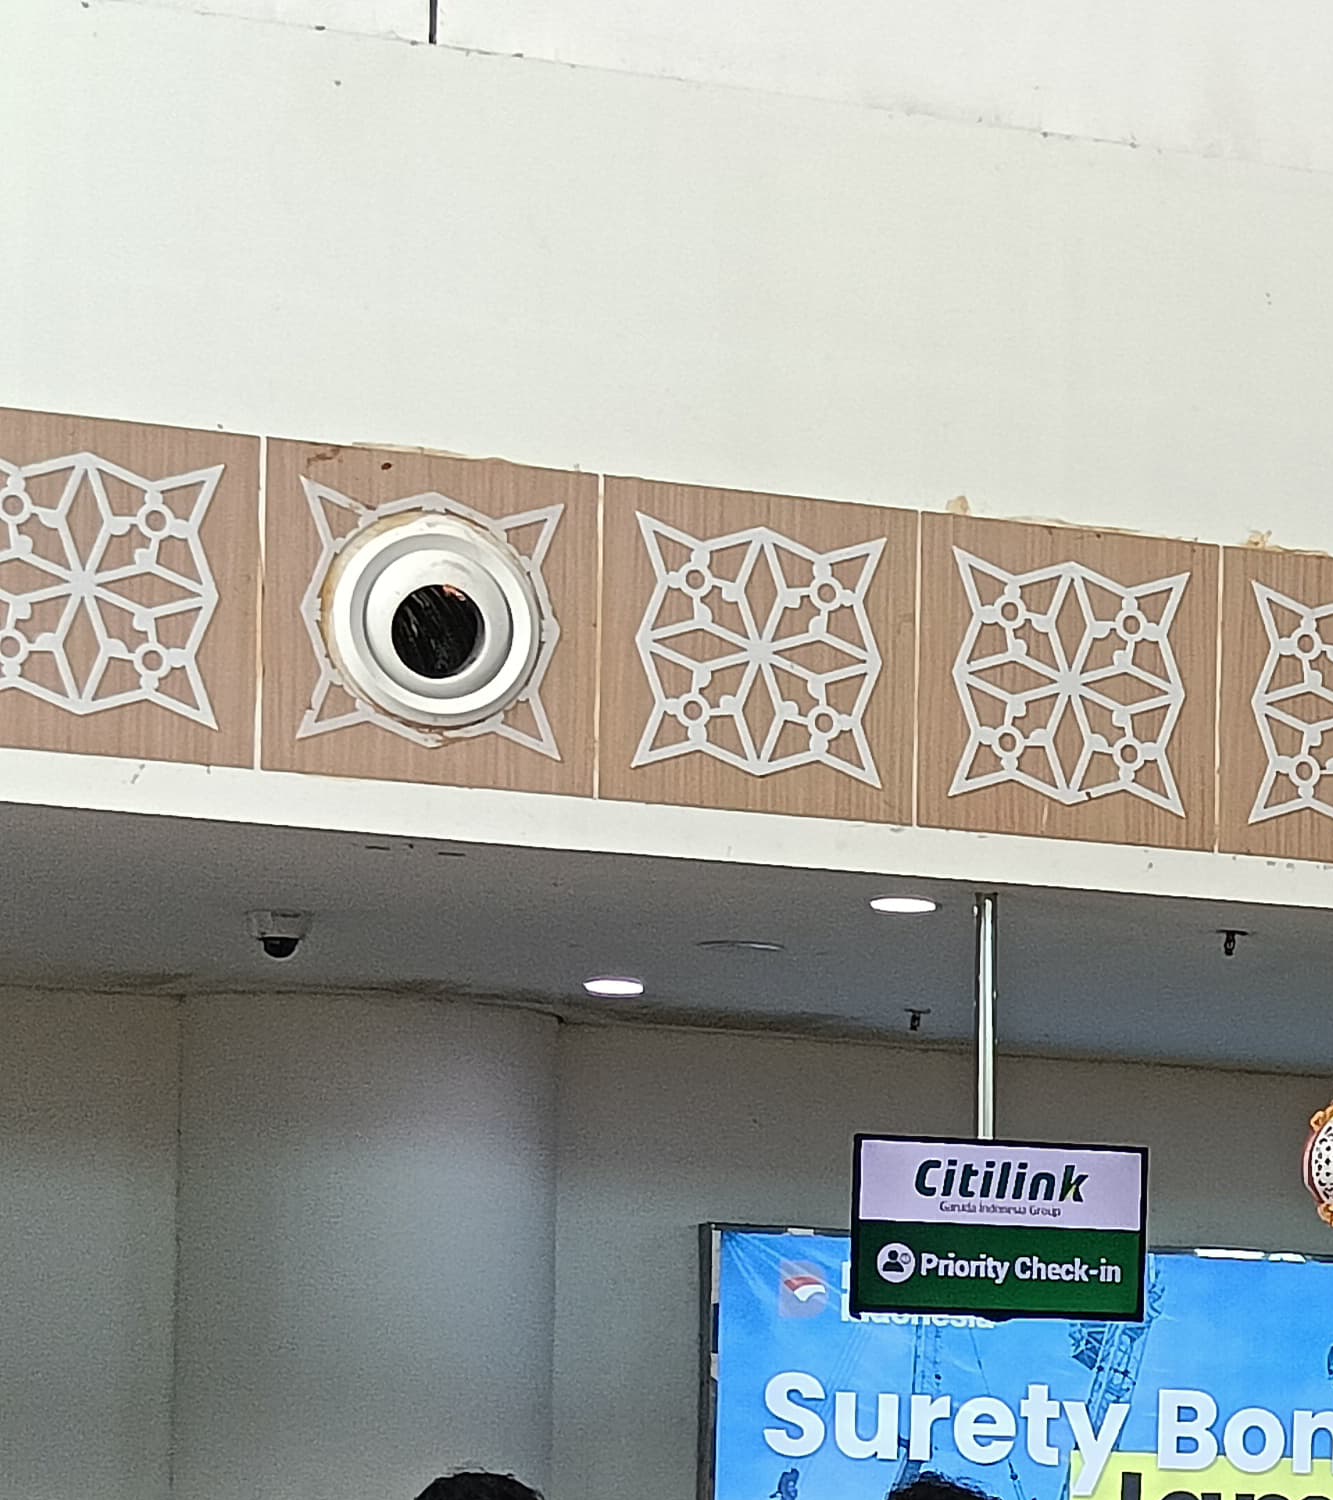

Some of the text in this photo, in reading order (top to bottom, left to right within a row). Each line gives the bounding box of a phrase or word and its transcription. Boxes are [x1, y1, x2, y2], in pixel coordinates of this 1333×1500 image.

[914, 1159, 1089, 1203] Citilink
[920, 1252, 1122, 1284] Priority Check-in
[762, 1372, 1131, 1498] Surety
